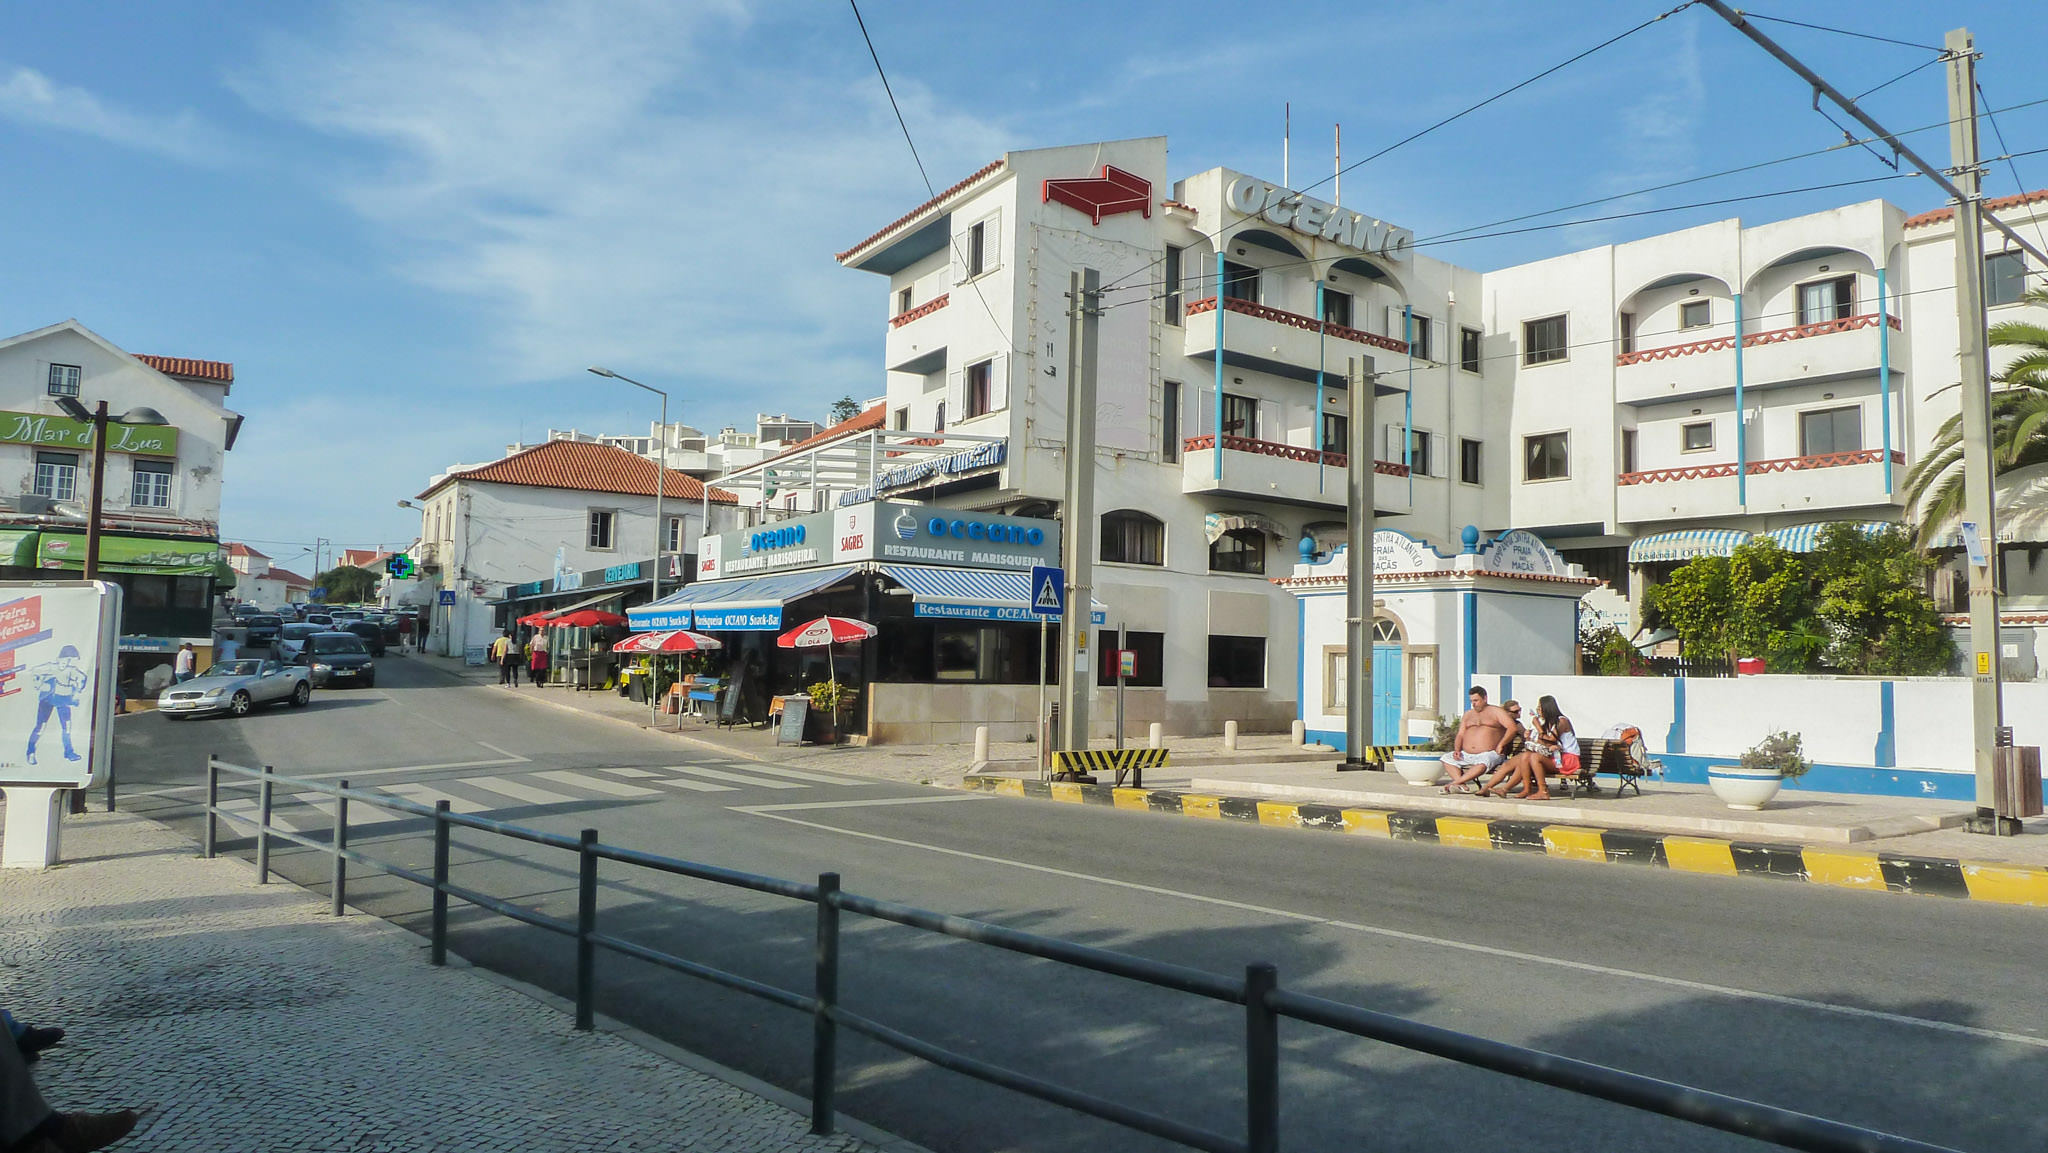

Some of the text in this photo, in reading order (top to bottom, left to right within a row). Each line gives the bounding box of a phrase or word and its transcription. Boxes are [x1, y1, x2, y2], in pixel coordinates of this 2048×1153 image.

[1226, 177, 1413, 262] OCEANO
[2, 415, 163, 452] Mar d Lua
[751, 524, 807, 553] oceano
[928, 517, 1045, 547] oceano
[841, 534, 865, 552] SAGRES
[1513, 545, 1532, 556] PRAIA
[725, 548, 819, 573] RESTAURANTE MARISQUEIRA
[884, 544, 1047, 567] RESTAURANTE MARISQUEIRA
[1638, 548, 1678, 560] Residencial
[701, 559, 716, 572] SAGRES
[1373, 560, 1398, 571] AÇÃS
[749, 613, 780, 626] Snack-Bar
[918, 603, 990, 618] Restaurante
